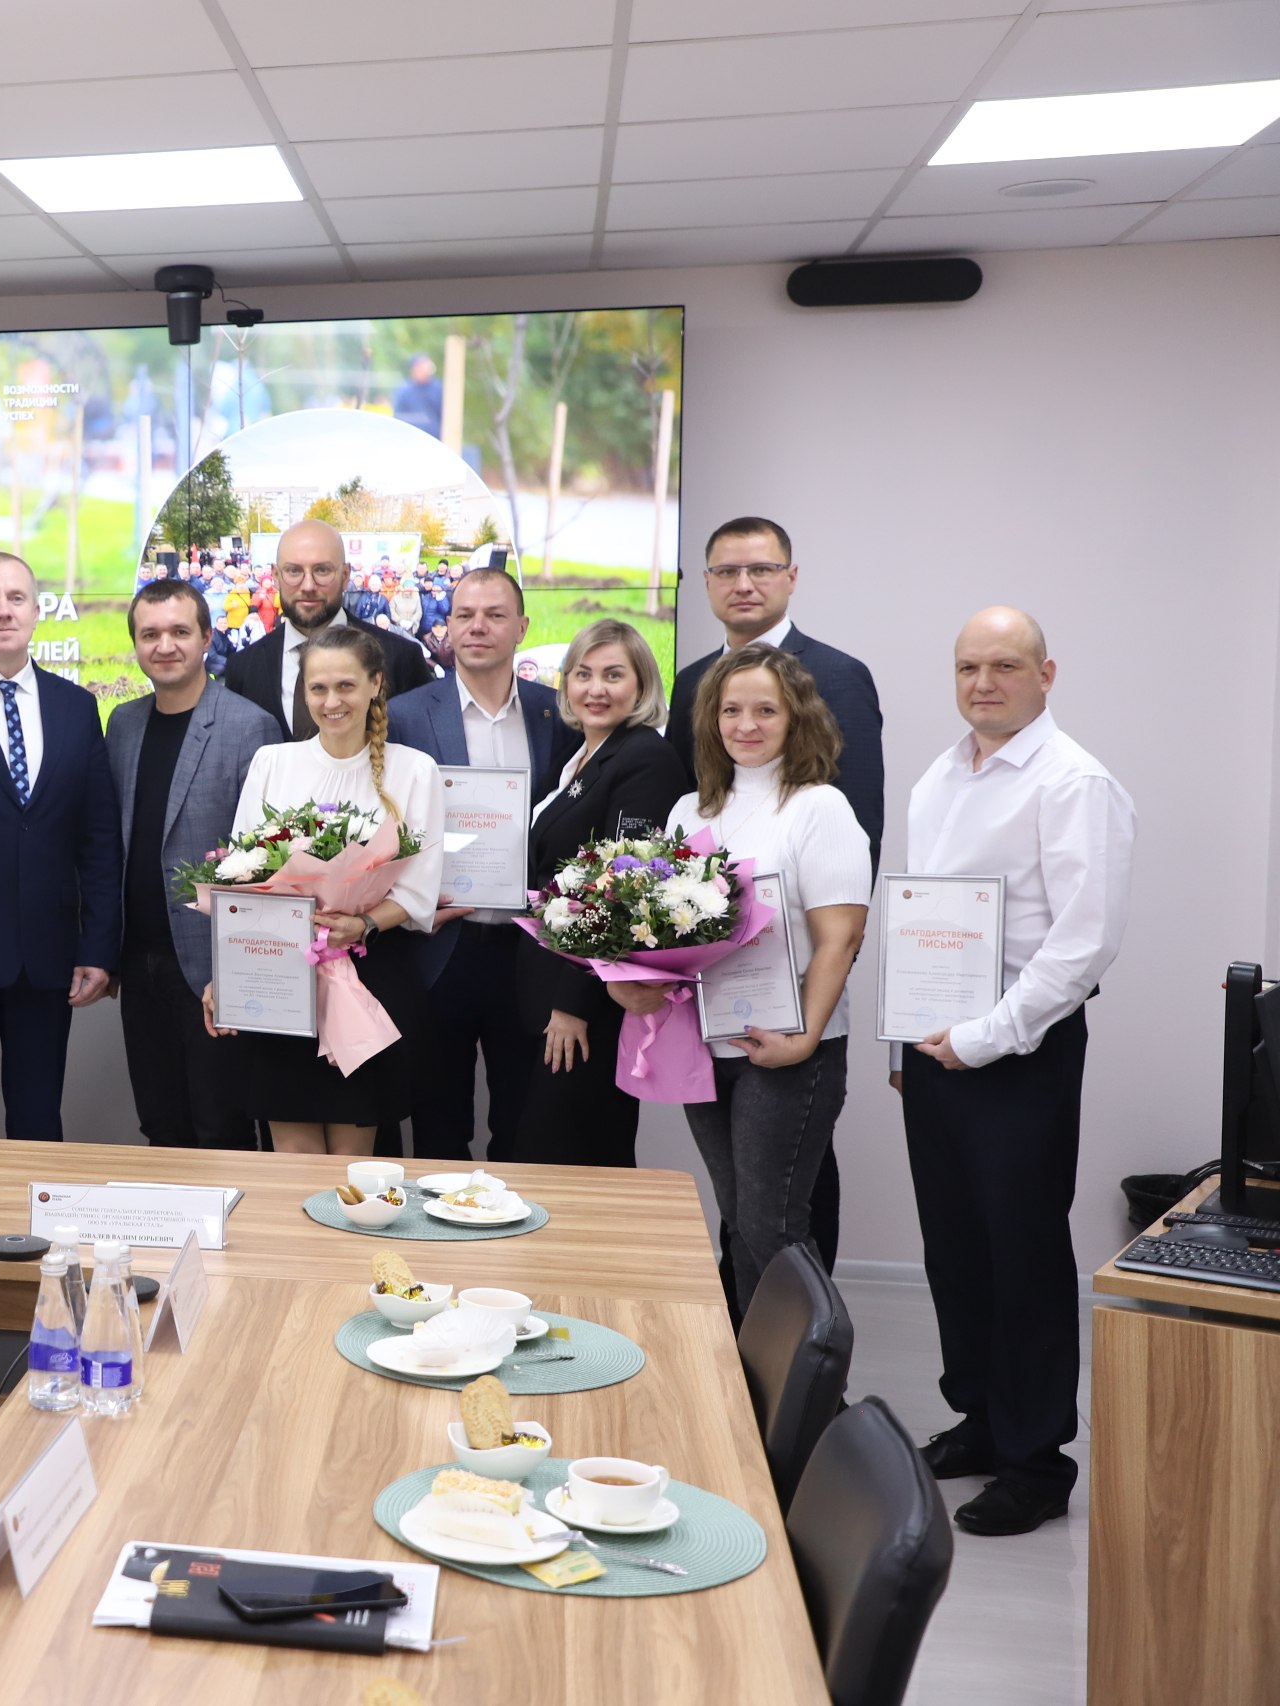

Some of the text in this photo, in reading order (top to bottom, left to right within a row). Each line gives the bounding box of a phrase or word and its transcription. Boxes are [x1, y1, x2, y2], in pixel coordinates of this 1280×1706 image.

[3, 383, 79, 395] ВОЗМОЖНОСТИ
[3, 397, 58, 408] ТРАДИЦИИ
[445, 811, 513, 821] ЛАГОДАРСТВЕННОЕ
[458, 819, 497, 829] ПИСЬМО
[900, 928, 984, 940] БЛАГОДАРСТВЕННОЕ
[228, 937, 300, 949] БЛАГОДАРСТВЕННОЕ
[918, 939, 964, 950] ПИСЬМО
[244, 946, 284, 957] ПИСЬМО
[138, 1235, 174, 1243] ЮРЬЕВИЧ
